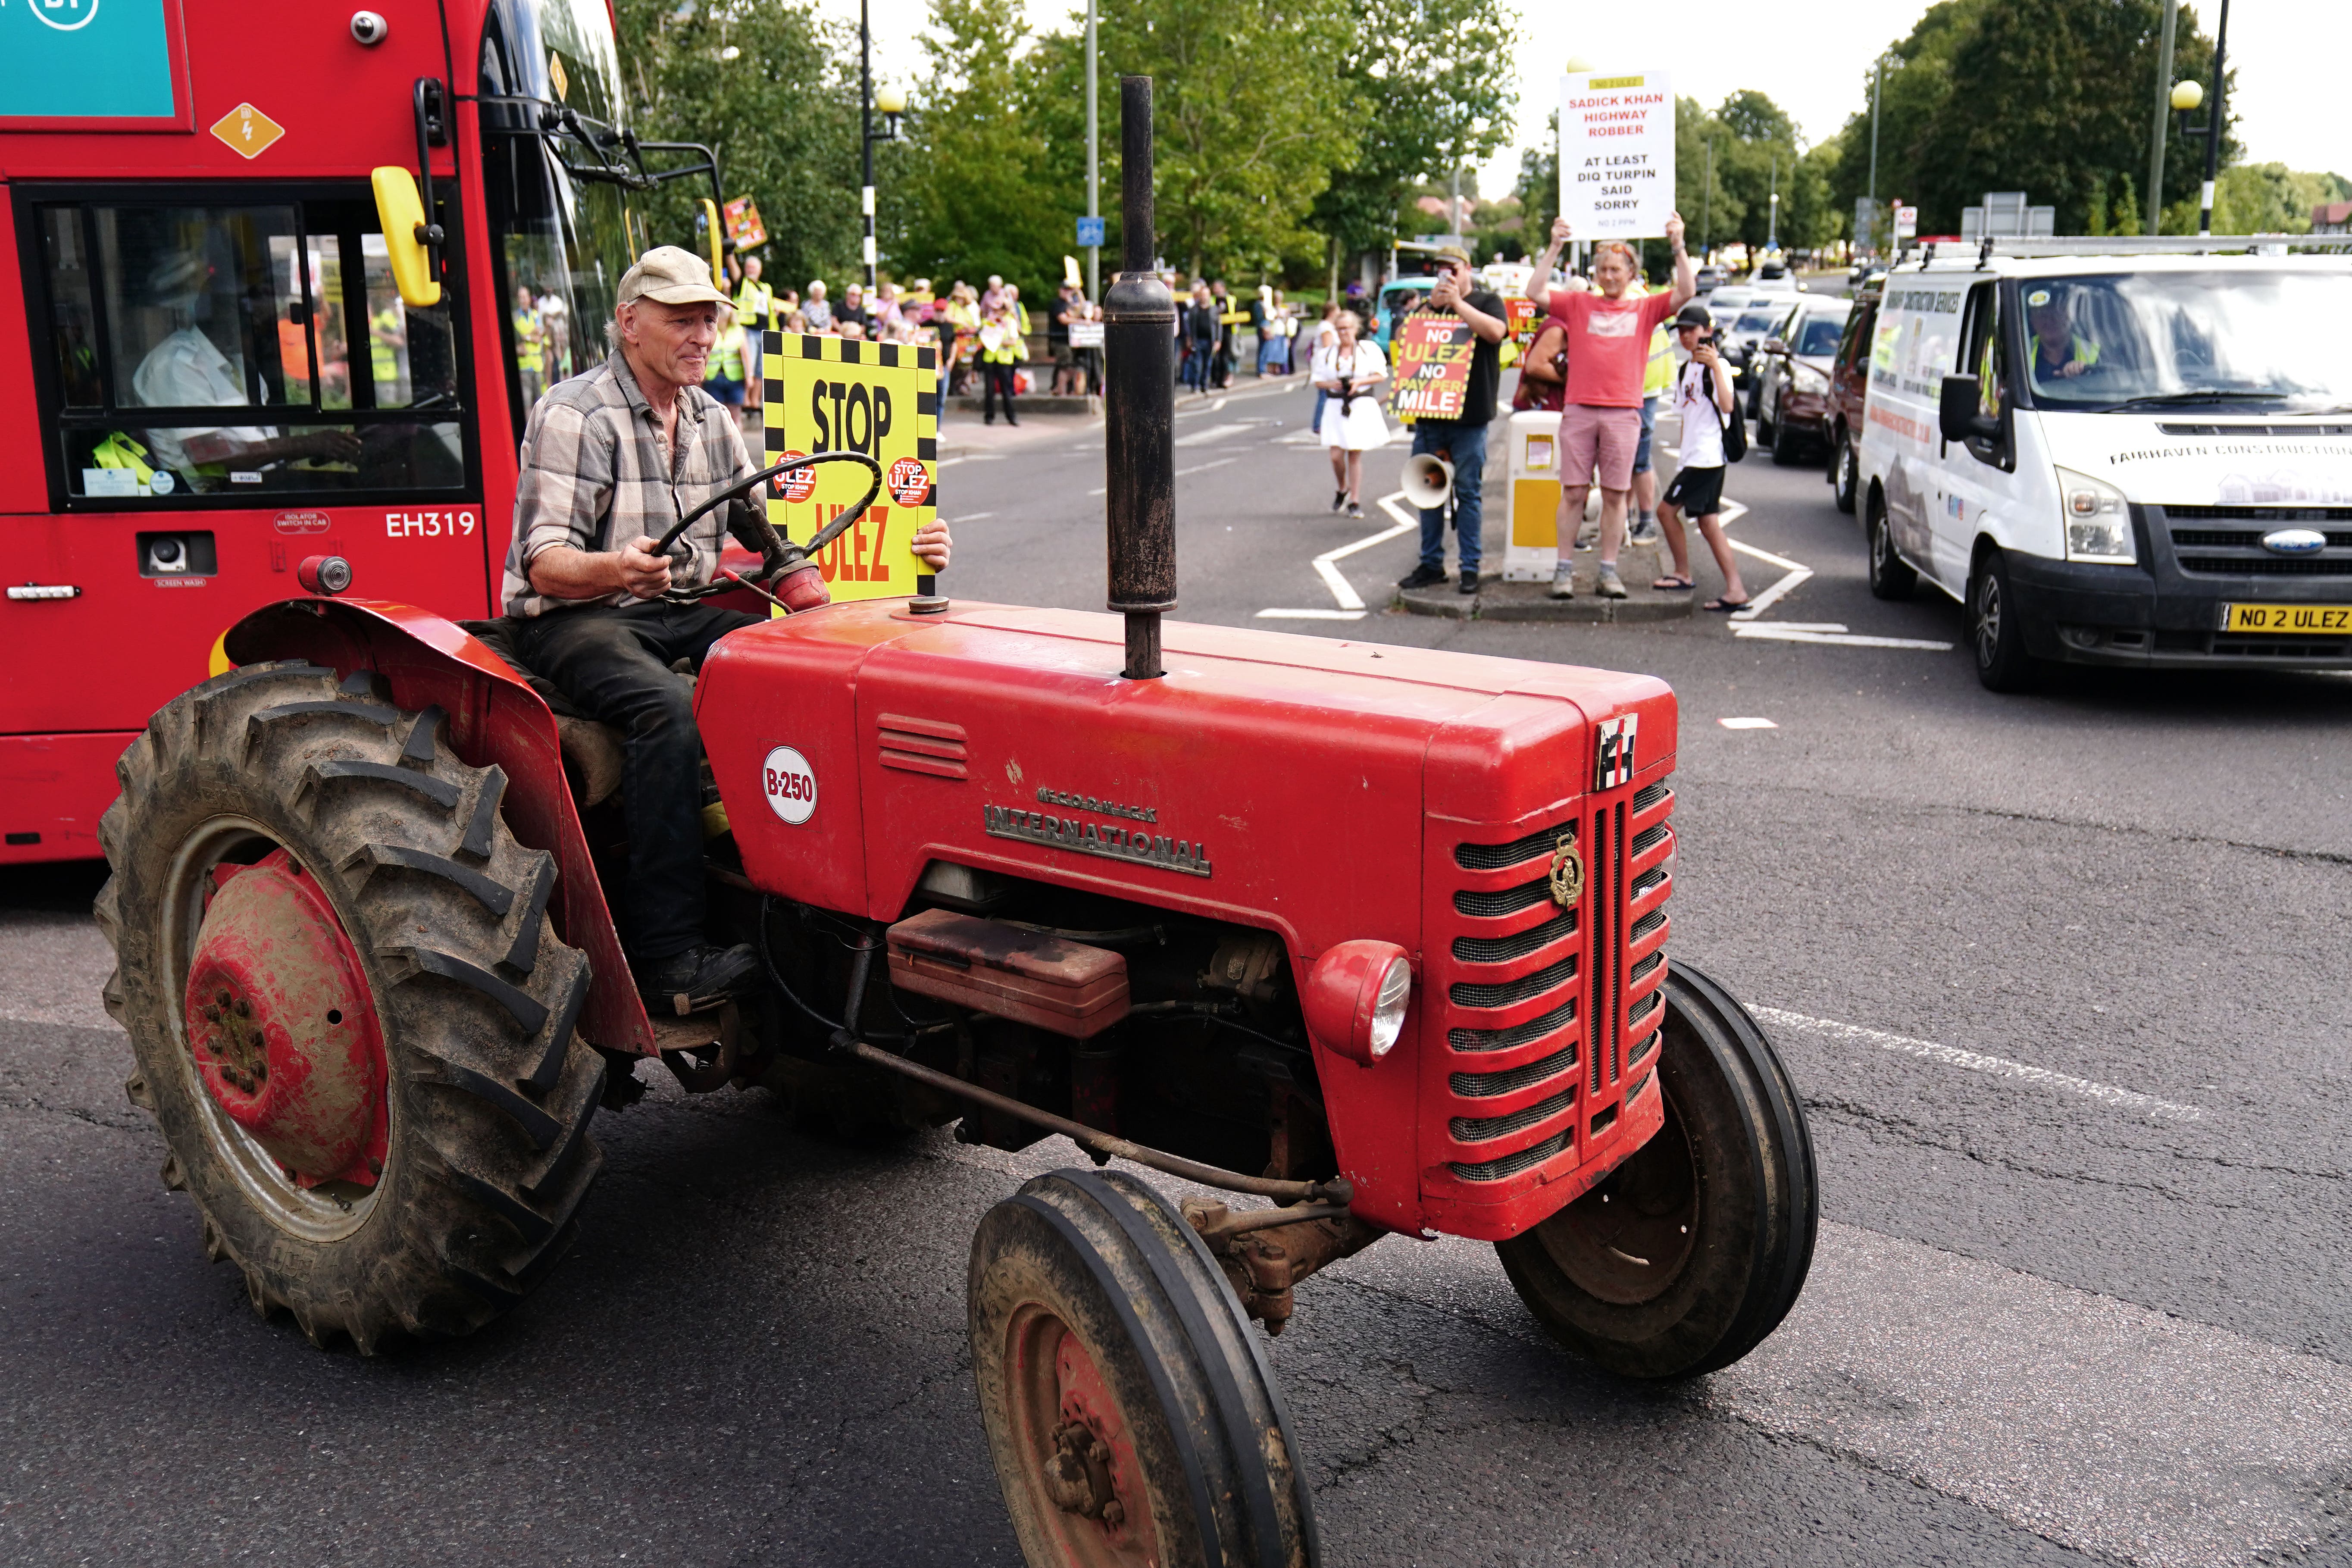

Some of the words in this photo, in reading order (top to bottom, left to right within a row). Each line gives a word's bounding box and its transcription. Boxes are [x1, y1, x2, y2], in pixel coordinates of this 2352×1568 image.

[1570, 96, 1619, 109] SADICK
[1624, 93, 1663, 104] KHAN
[1584, 109, 1648, 123] HIGHWAY
[1589, 125, 1644, 137] ROBBER
[1585, 157, 1601, 167] AT
[1606, 154, 1648, 166] LEAST
[1606, 169, 1655, 180] TURPIN
[1601, 185, 1632, 195] SAID
[1595, 199, 1639, 210] SORRY
[1518, 307, 1536, 317] NO
[1426, 329, 1453, 344] NO
[1405, 343, 1468, 363] ULEZ
[1419, 364, 1447, 379] NO
[1398, 377, 1429, 391] PAY
[1430, 379, 1462, 393] PER
[1398, 389, 1457, 411] MILE
[812, 379, 891, 461] STOP
[895, 464, 922, 475] STOP
[889, 473, 928, 489] ULEZ
[386, 511, 475, 537] EH319
[816, 504, 889, 583] ULEZ
[2240, 609, 2266, 626] NO
[2274, 610, 2287, 627] 2
[2295, 610, 2349, 628] ULEZ
[766, 768, 813, 802] B-250
[983, 804, 1211, 871] INTERNATIONAL
